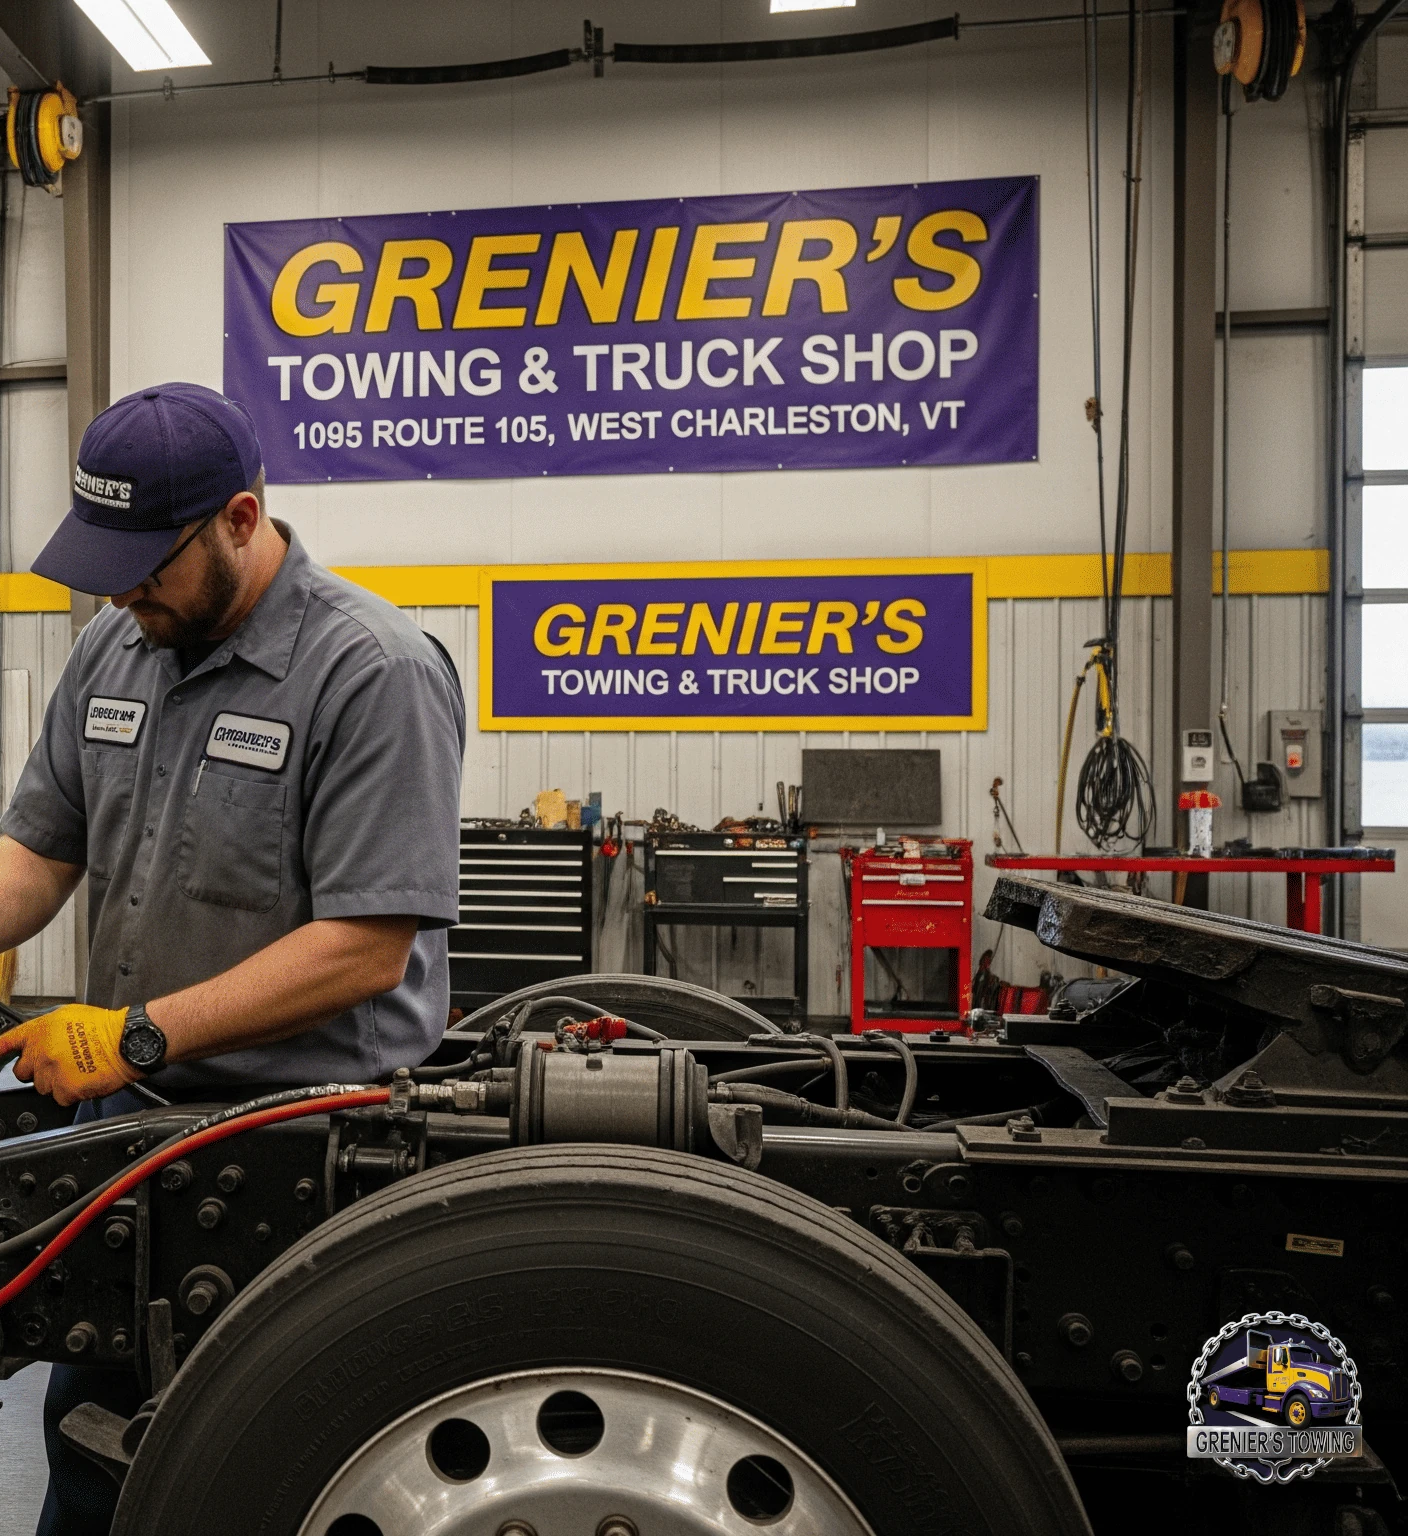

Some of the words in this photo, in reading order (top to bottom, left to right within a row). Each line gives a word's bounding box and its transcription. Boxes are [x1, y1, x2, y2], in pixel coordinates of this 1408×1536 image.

[271, 211, 988, 337] GRENIER'S
[268, 347, 502, 401] TOWING
[518, 346, 559, 395] &
[573, 337, 785, 392] TRUCK
[800, 330, 978, 385] SHOP
[293, 421, 363, 450] 1095
[372, 416, 485, 448] ROUTE
[495, 414, 555, 447] 105,
[567, 410, 663, 442] WEST
[670, 402, 910, 438] CHARLESTON,
[919, 400, 966, 430] VT
[533, 598, 927, 657] GRENIER'S
[541, 669, 669, 696] TOWING
[678, 669, 700, 695] &
[706, 667, 820, 695] TRUCK
[828, 666, 920, 695] SHOP
